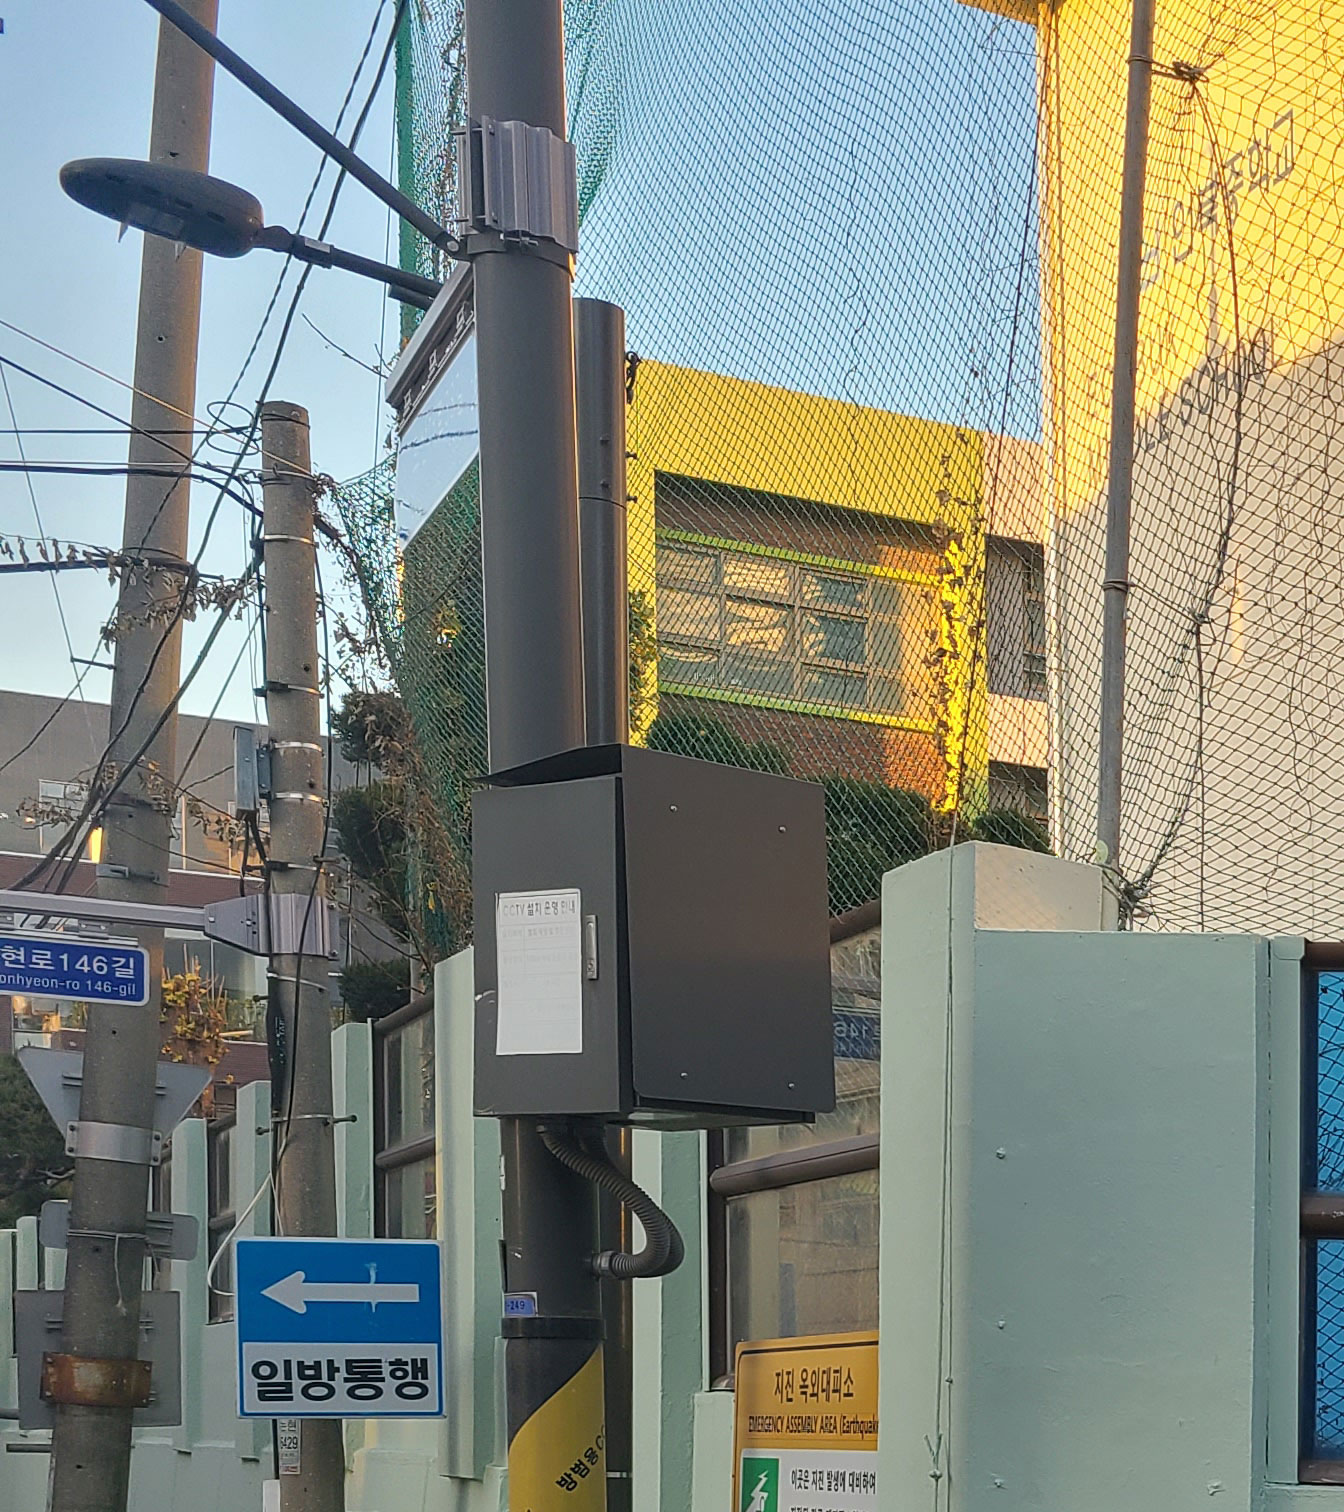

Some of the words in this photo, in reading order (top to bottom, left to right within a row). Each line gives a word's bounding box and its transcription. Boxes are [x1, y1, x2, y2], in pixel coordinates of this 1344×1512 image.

[503, 903, 525, 917] CCTV
[0, 945, 136, 979] 현로146길
[86, 980, 136, 997] 146-gil
[251, 1357, 430, 1402] 일방통행
[774, 1368, 795, 1404] 지진
[798, 1366, 855, 1404] 옥외대피소
[748, 1415, 784, 1433] EMERGENCY
[785, 1415, 818, 1434] ASSEMBLY
[819, 1415, 838, 1434] AREA
[555, 1447, 599, 1492] 방범용
[791, 1469, 810, 1491] 이곳은
[811, 1469, 825, 1492] 지진
[827, 1470, 847, 1493] 발생에
[848, 1471, 876, 1495] 대비하여
